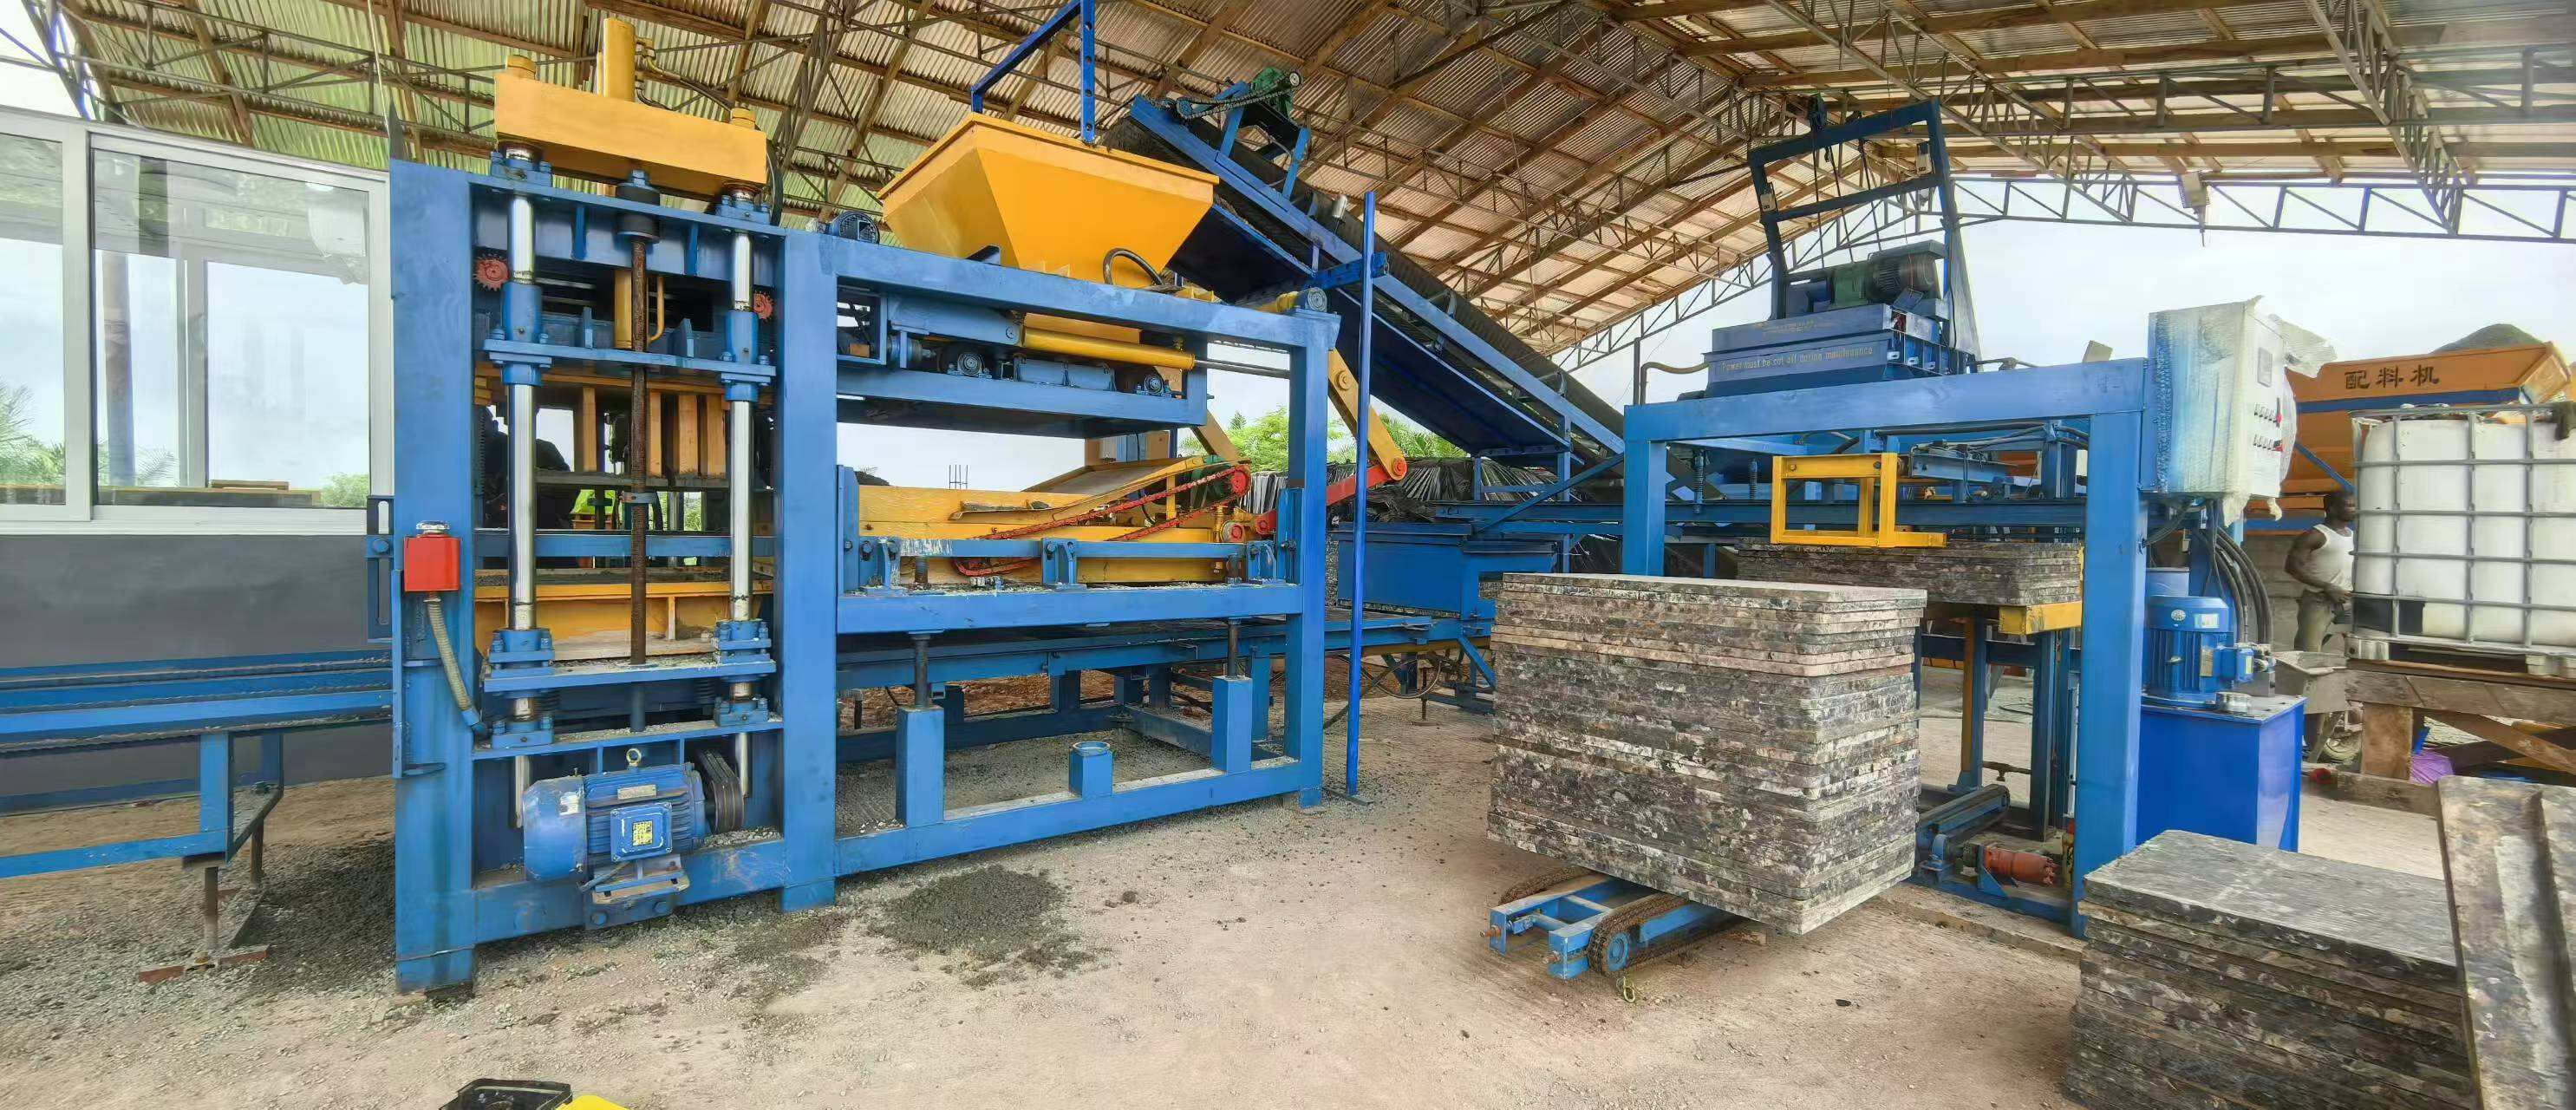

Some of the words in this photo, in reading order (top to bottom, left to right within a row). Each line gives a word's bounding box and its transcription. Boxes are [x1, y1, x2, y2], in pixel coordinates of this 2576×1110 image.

[1763, 357, 1771, 368] be
[2344, 364, 2440, 389] 配料机
